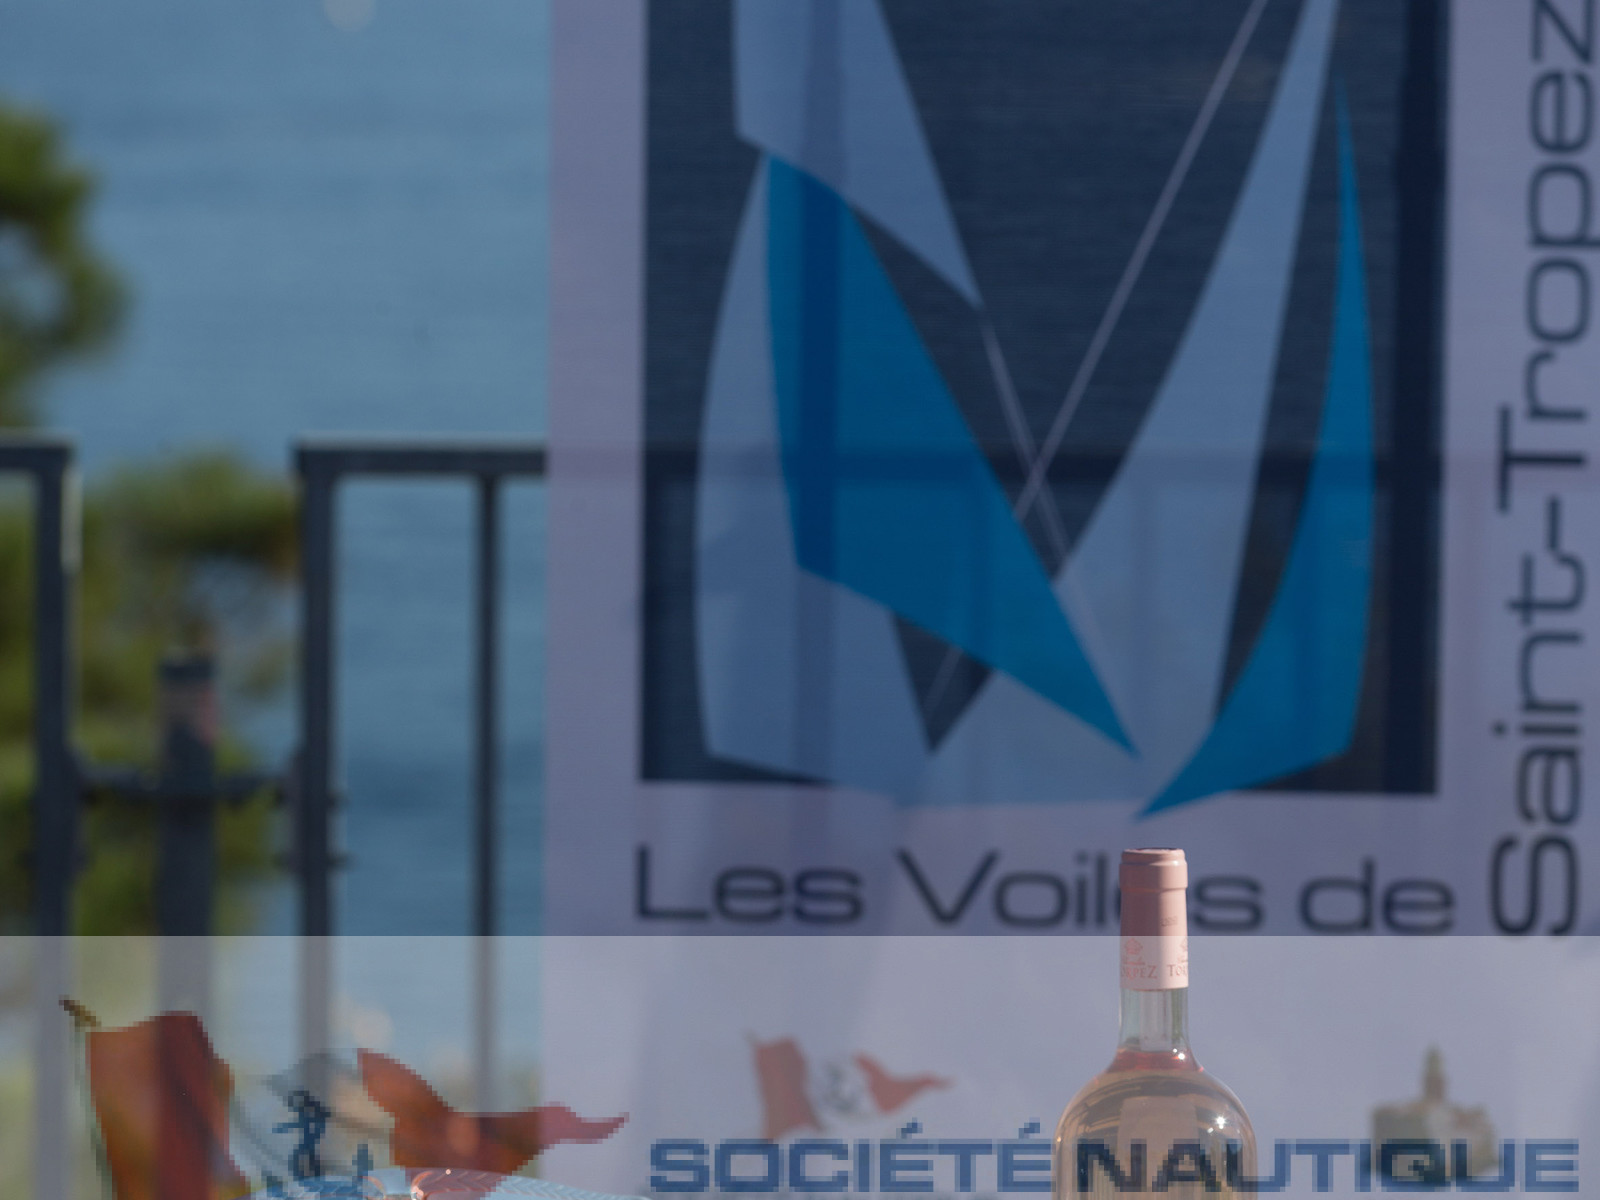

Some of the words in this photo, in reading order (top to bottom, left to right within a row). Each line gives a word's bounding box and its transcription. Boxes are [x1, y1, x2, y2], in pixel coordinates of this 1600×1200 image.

[634, 847, 863, 923] Les
[897, 847, 1264, 927] Voils
[1300, 856, 1455, 932] de
